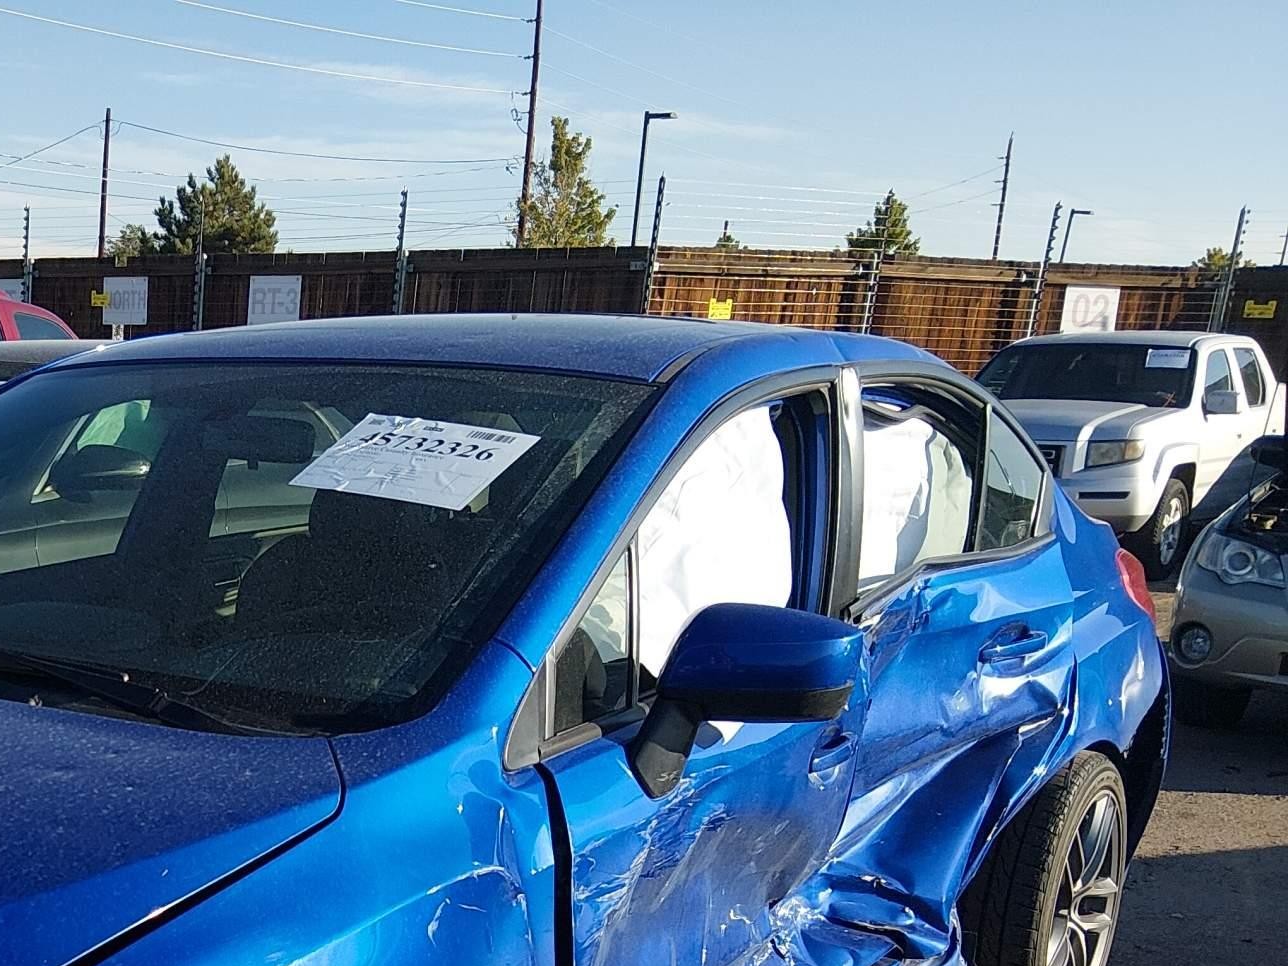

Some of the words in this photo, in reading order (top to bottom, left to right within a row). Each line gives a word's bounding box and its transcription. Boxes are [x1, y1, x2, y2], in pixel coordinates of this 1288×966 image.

[251, 288, 298, 315] RT-3
[1071, 294, 1110, 328] 02
[359, 432, 501, 461] 45732326
